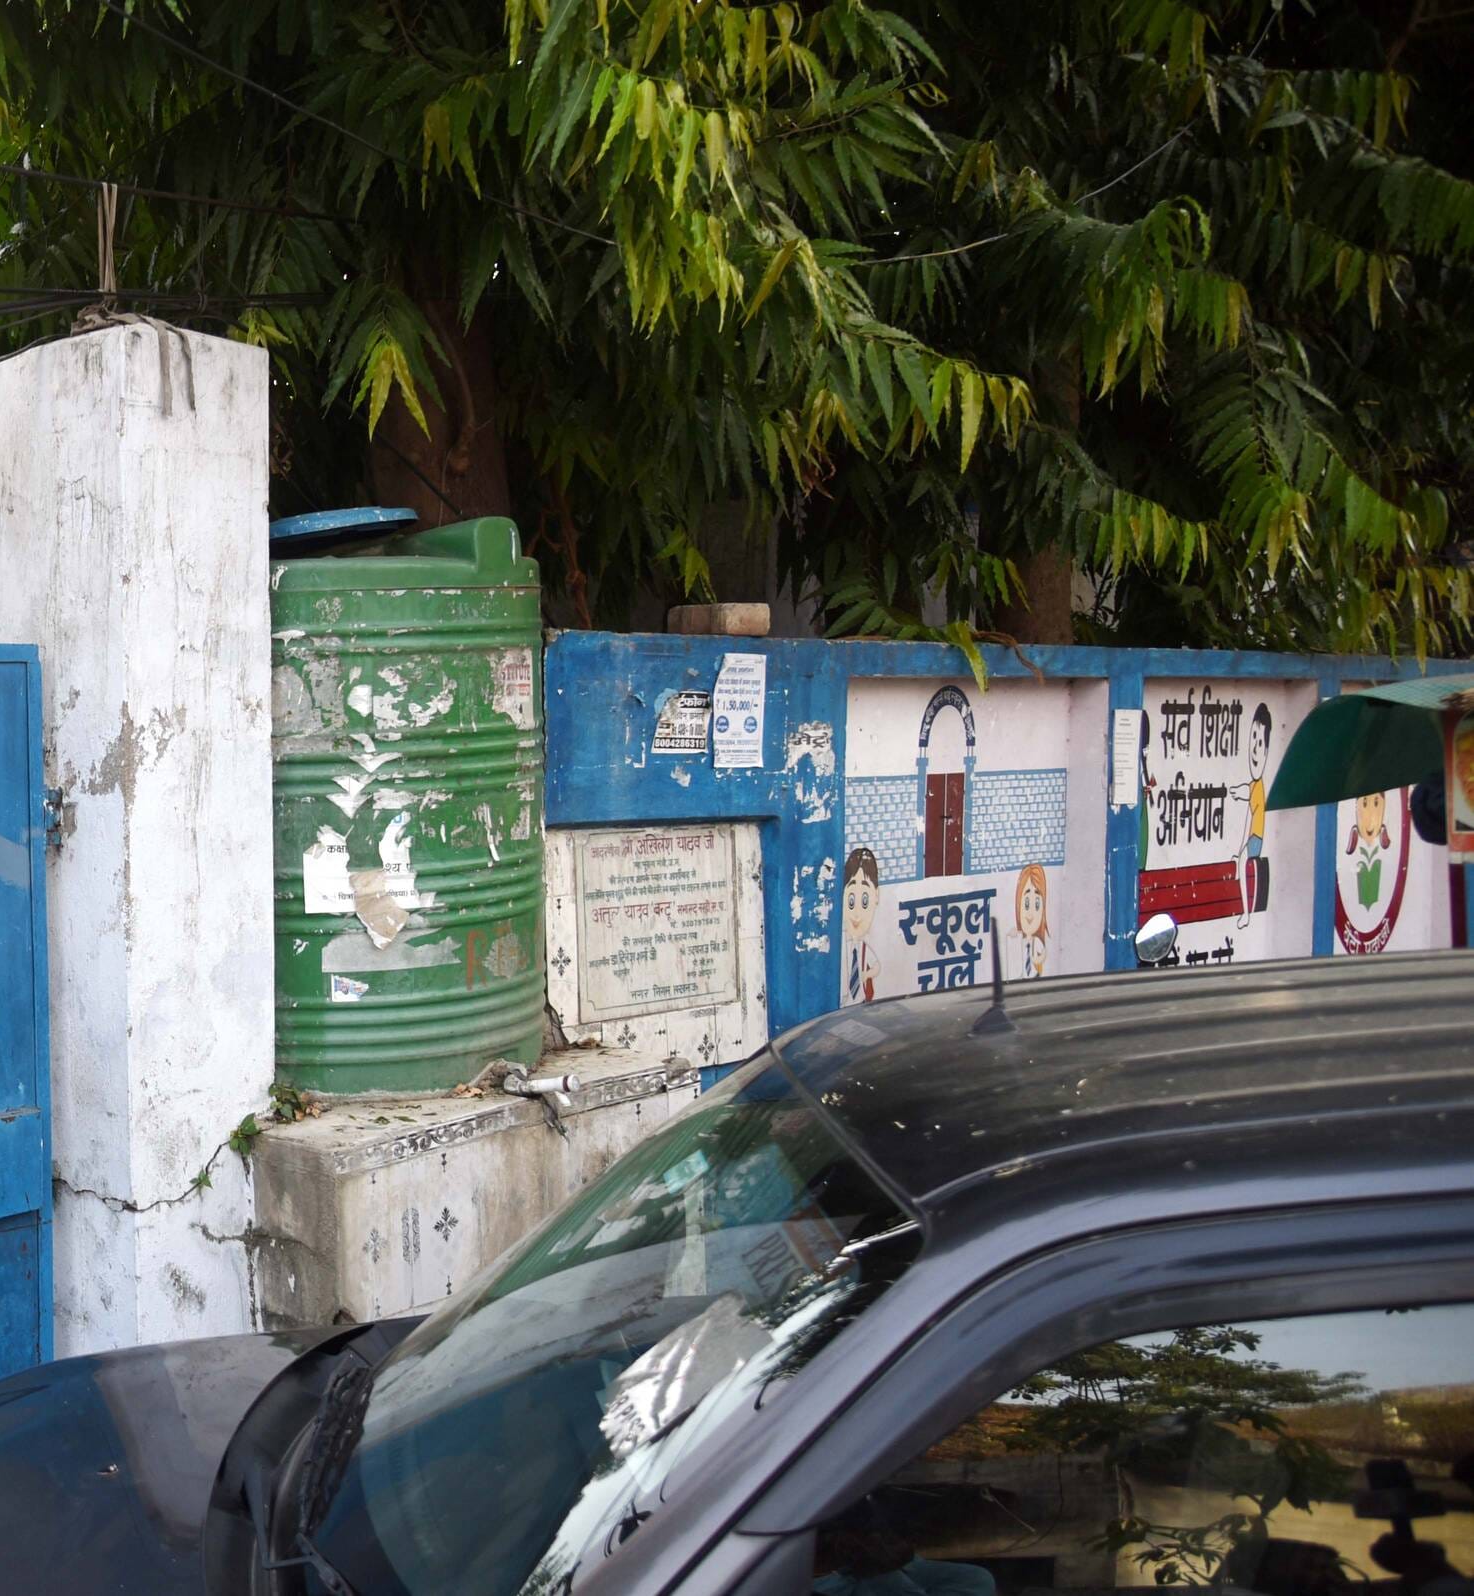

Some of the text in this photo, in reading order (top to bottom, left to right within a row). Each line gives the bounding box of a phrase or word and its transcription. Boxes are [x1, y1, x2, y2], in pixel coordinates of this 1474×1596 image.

[1161, 685, 1243, 759] सर्व शिक्षा
[1156, 771, 1228, 846] अभियान
[899, 889, 997, 955] स्कूल
[741, 1231, 807, 1299] PRES
